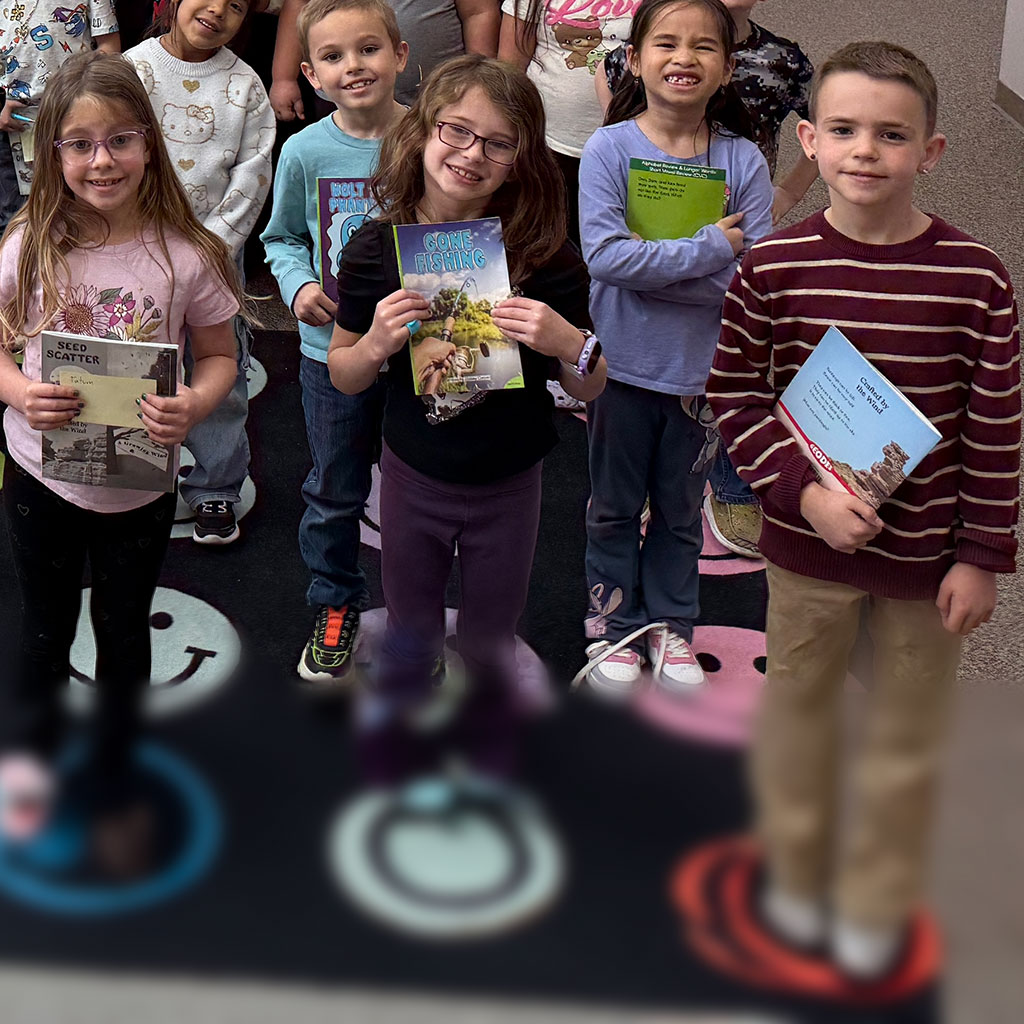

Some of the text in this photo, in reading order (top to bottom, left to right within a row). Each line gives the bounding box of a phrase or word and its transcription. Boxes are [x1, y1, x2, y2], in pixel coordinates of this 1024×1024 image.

[423, 229, 473, 253] GONE
[415, 248, 487, 274] FISHING
[46, 349, 100, 365] SCATTER
[57, 341, 87, 352] SEED
[856, 384, 884, 415] the Wind
[859, 376, 890, 410] Crafted by
